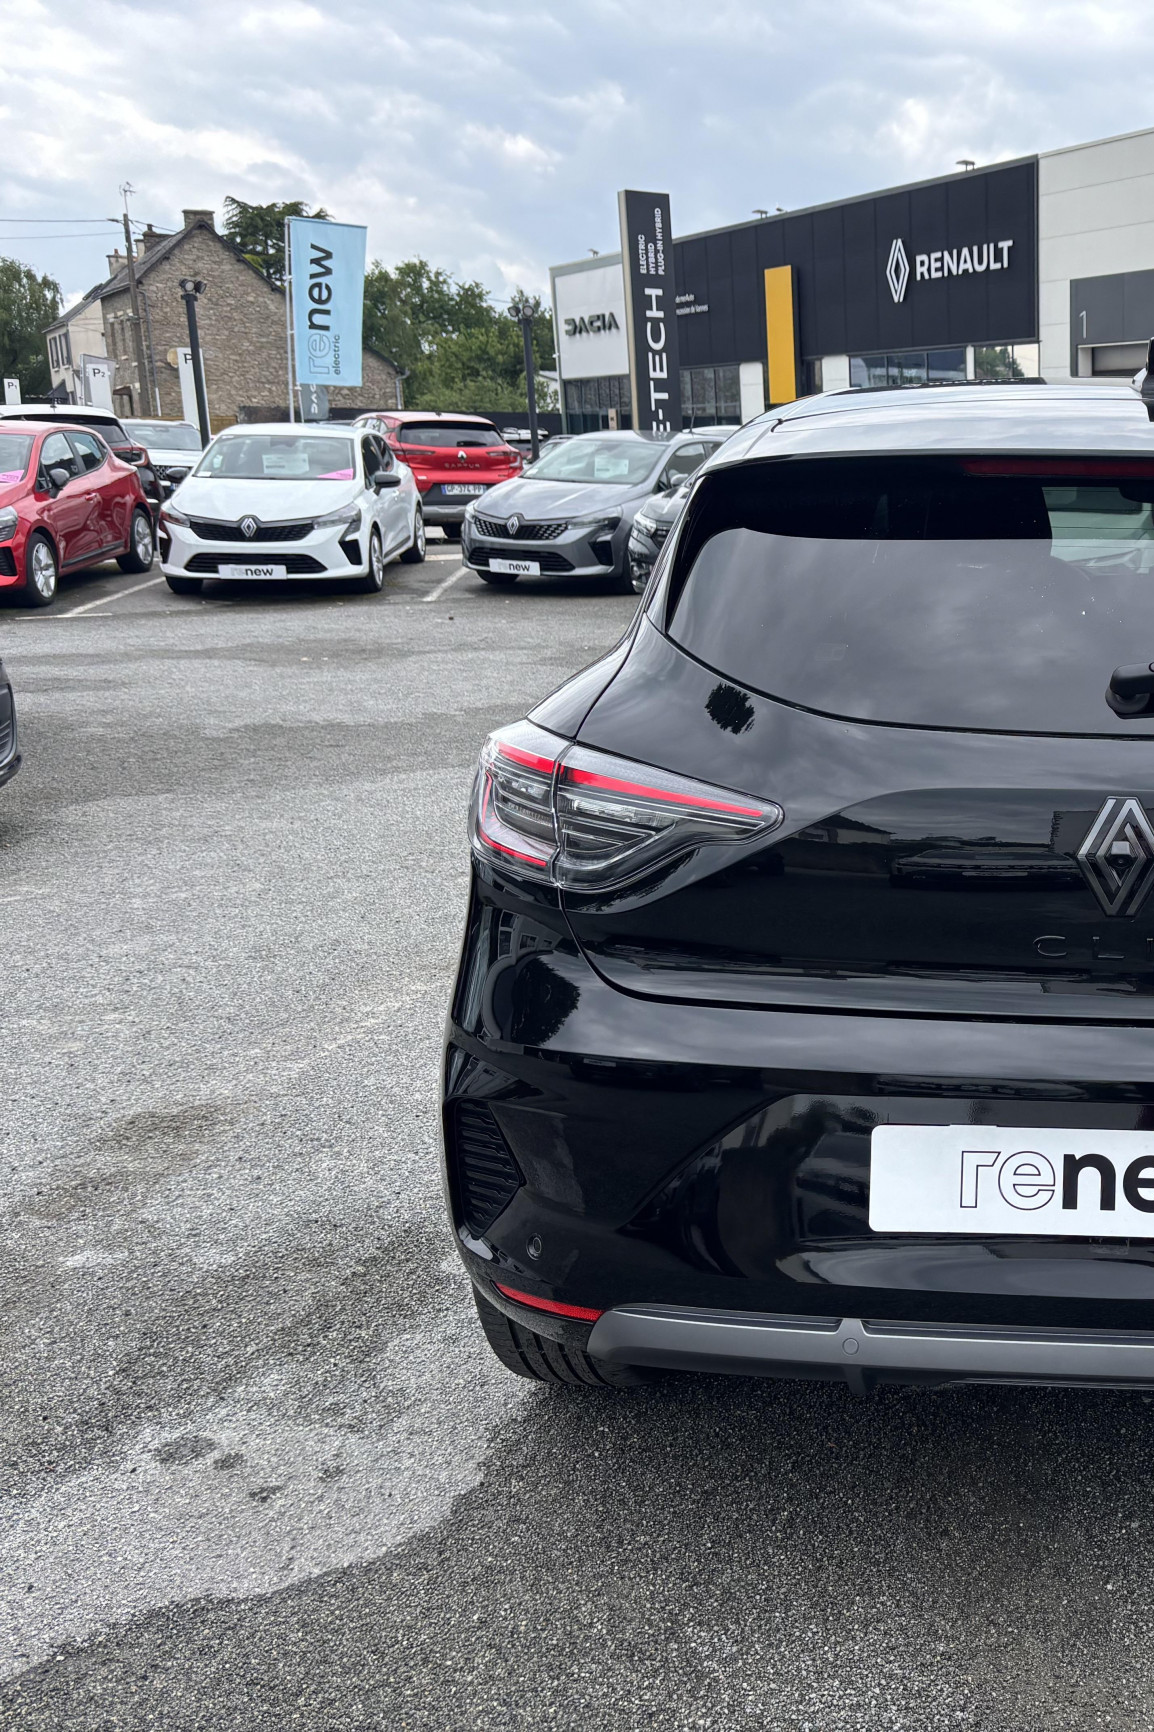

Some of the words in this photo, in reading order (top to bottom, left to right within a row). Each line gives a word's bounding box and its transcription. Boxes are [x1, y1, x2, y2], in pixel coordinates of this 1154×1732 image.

[638, 234, 647, 274] ELECTRIC
[648, 243, 656, 275] HYBRID
[657, 241, 665, 275] PLUG-IN
[915, 240, 1013, 281] RENAULT
[308, 243, 333, 375] renew
[564, 312, 620, 336] DACIA
[1079, 310, 1087, 339] 1
[332, 334, 340, 375] electric
